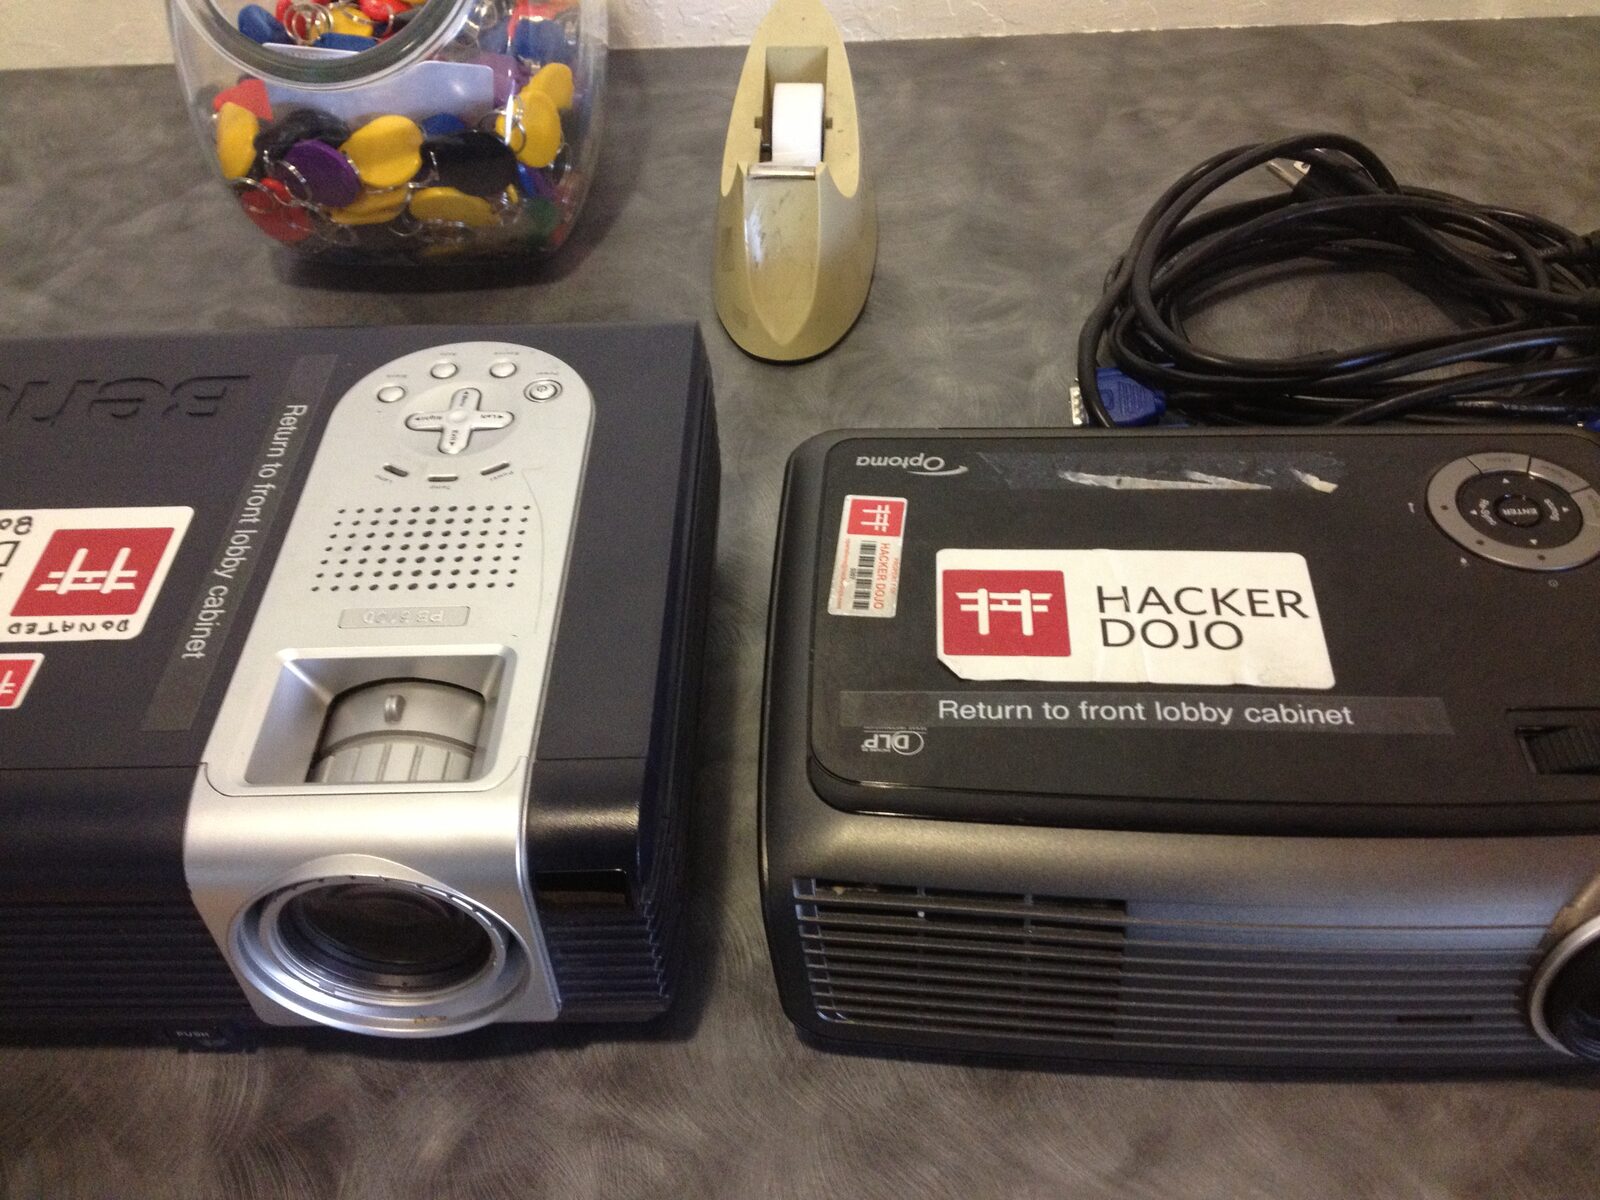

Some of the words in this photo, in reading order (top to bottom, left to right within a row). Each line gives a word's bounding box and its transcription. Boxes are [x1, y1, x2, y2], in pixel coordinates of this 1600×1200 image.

[0, 376, 250, 426] Ben
[266, 405, 307, 458] Return
[258, 462, 283, 478] to
[855, 452, 945, 471] Optoma
[238, 483, 276, 524] front
[1502, 507, 1538, 516] ENTER
[213, 529, 258, 579] lobby
[877, 542, 891, 580] HACKER
[873, 583, 886, 610] DOJO
[1096, 585, 1310, 619] HACKER
[8, 619, 130, 635] DONATED
[181, 585, 229, 660] cabinet
[1100, 618, 1244, 651] DOJO
[938, 699, 1033, 721] Return
[1043, 702, 1070, 722] to
[1079, 702, 1147, 723] front
[1156, 701, 1233, 726] lobby
[1244, 704, 1355, 726] cabinet
